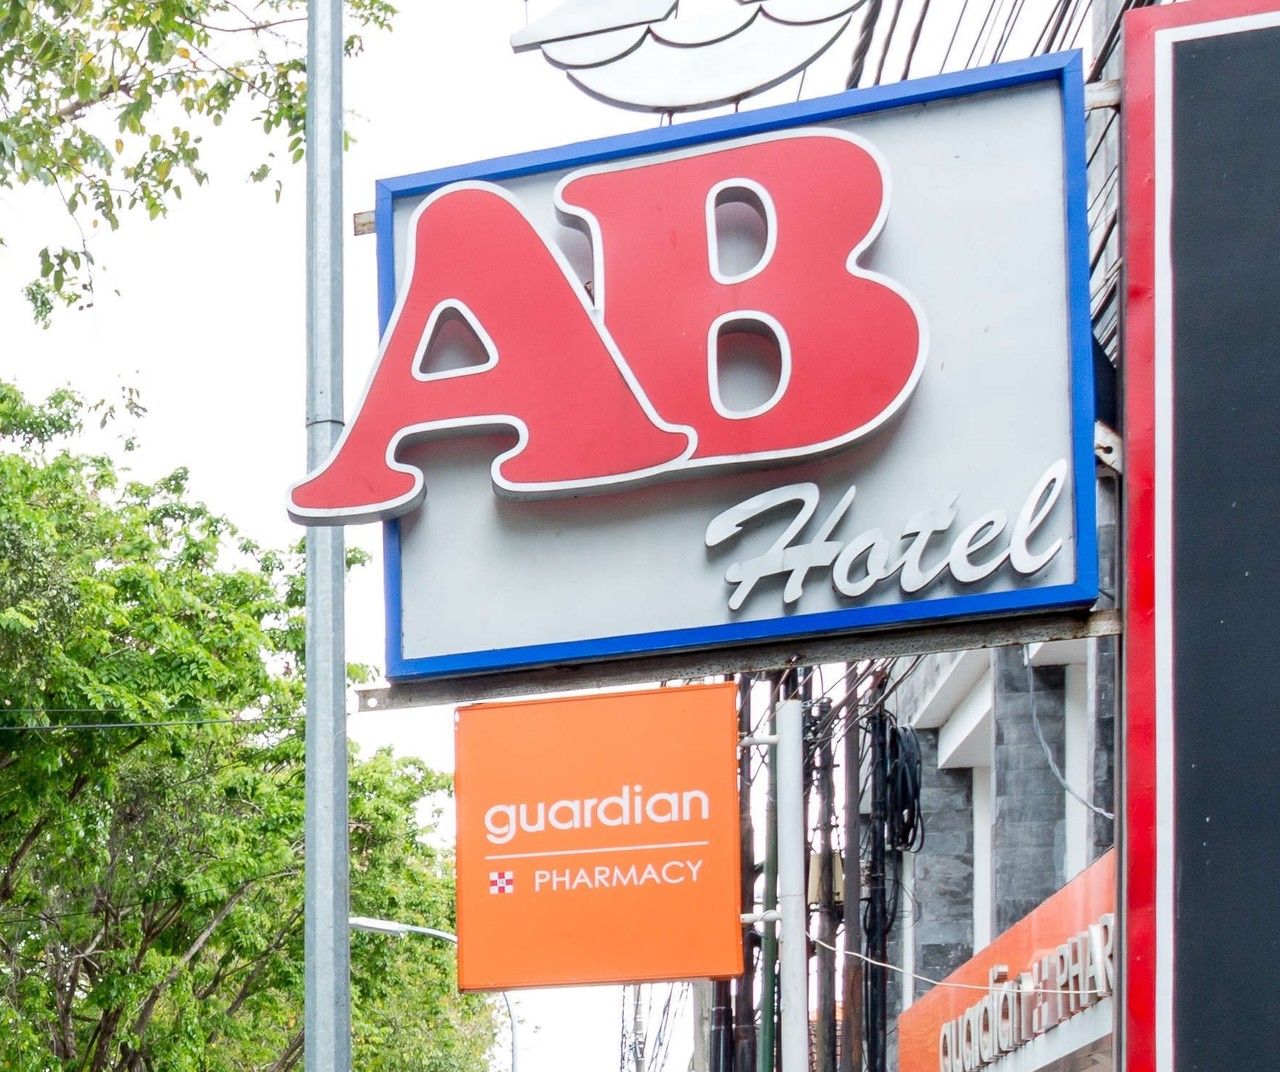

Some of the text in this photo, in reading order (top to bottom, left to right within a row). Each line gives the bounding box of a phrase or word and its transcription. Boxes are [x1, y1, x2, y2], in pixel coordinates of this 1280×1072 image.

[287, 127, 929, 524] AB
[705, 459, 1067, 610] Hotel
[484, 785, 709, 844] guardian
[535, 860, 703, 892] PHARMACY
